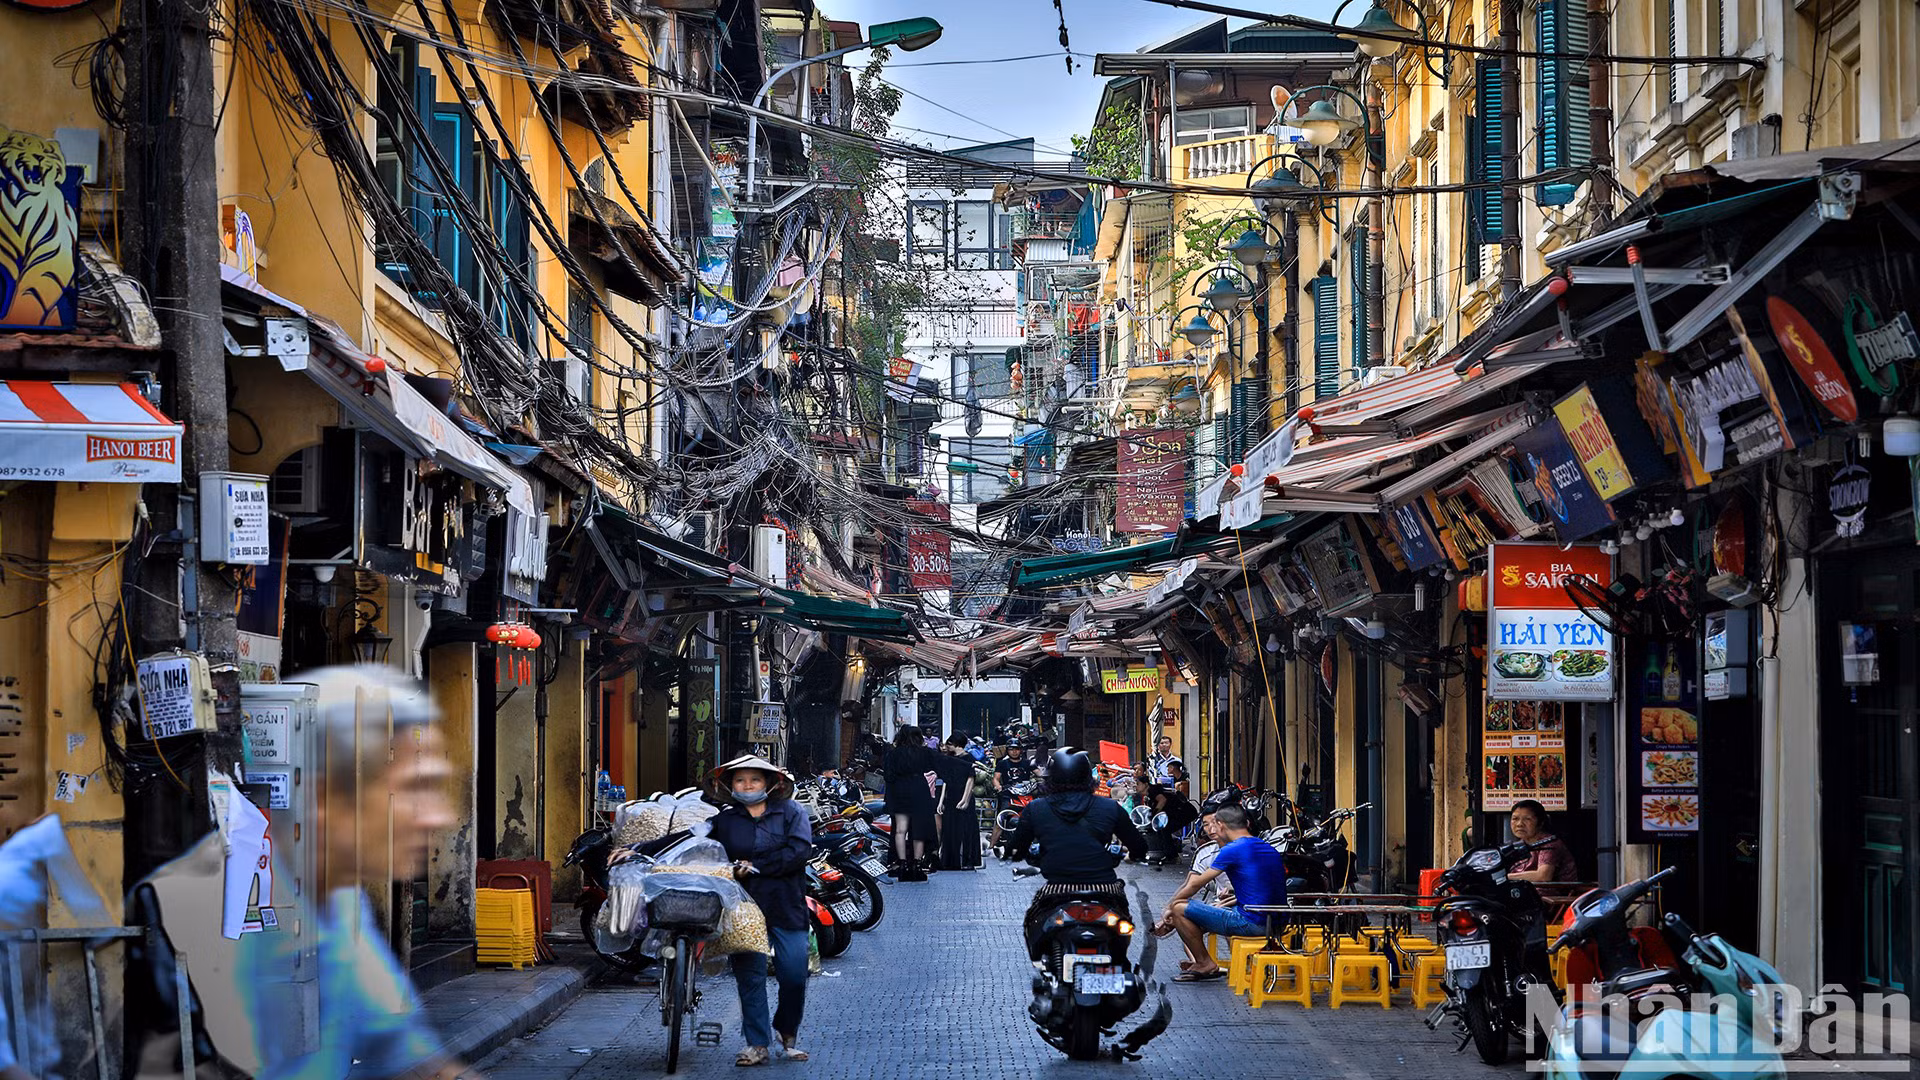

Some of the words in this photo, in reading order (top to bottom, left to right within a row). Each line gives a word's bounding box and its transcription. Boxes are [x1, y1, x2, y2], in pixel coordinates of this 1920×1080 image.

[1814, 379, 1848, 401] SAIGON
[90, 438, 135, 459] HANOI
[138, 439, 173, 461] BEER
[20, 467, 40, 477] 932
[44, 467, 65, 477] 678
[1552, 464, 1573, 489] BEER
[1066, 529, 1091, 539] Hanoi
[911, 555, 950, 573] 30-50%
[1551, 563, 1574, 573] BIA
[1500, 616, 1547, 645] HẢI
[1553, 614, 1604, 645] YẾN
[141, 664, 161, 693] SỬA
[164, 663, 188, 689] NHÀ
[1129, 673, 1158, 690] NƯỚNG
[256, 711, 278, 724] GẦN
[164, 720, 178, 735] 721
[254, 749, 277, 757] GƯỜI
